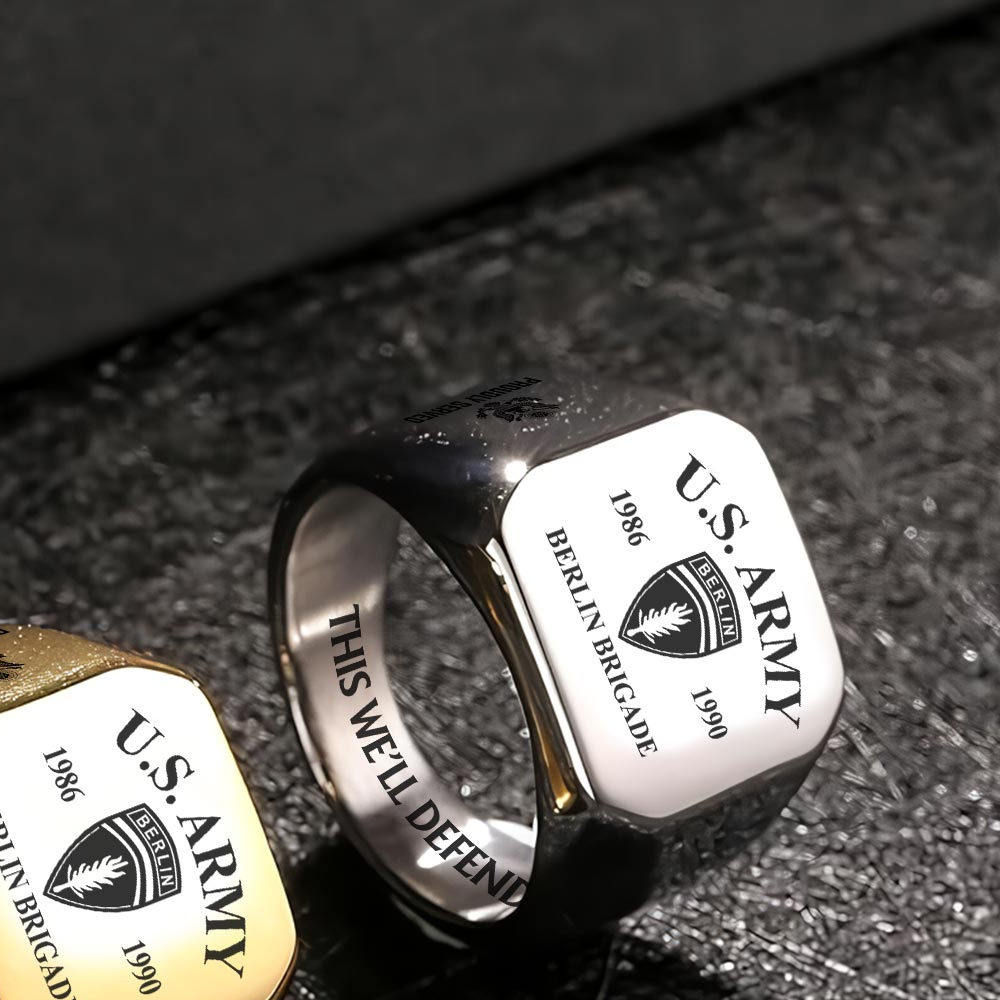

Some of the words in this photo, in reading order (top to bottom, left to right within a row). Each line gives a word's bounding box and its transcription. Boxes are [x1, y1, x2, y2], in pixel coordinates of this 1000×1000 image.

[403, 400, 472, 424] SERVED
[465, 377, 542, 403] PROUDLY
[608, 489, 651, 547] 1986
[674, 452, 749, 555] U.S.
[735, 566, 801, 729] ARMY
[698, 562, 735, 635] BERLIN
[329, 603, 371, 698] THIS
[545, 526, 608, 633] BERLIN
[592, 635, 660, 759] BRIGADE
[690, 686, 728, 741] 1990
[43, 746, 85, 803] 1986
[349, 697, 418, 807] WE'LL
[115, 708, 195, 804] U.S.
[176, 815, 246, 979] ARMY
[136, 814, 175, 886] BERLIN
[405, 798, 529, 907] DEFEND
[121, 939, 162, 996] 1990
